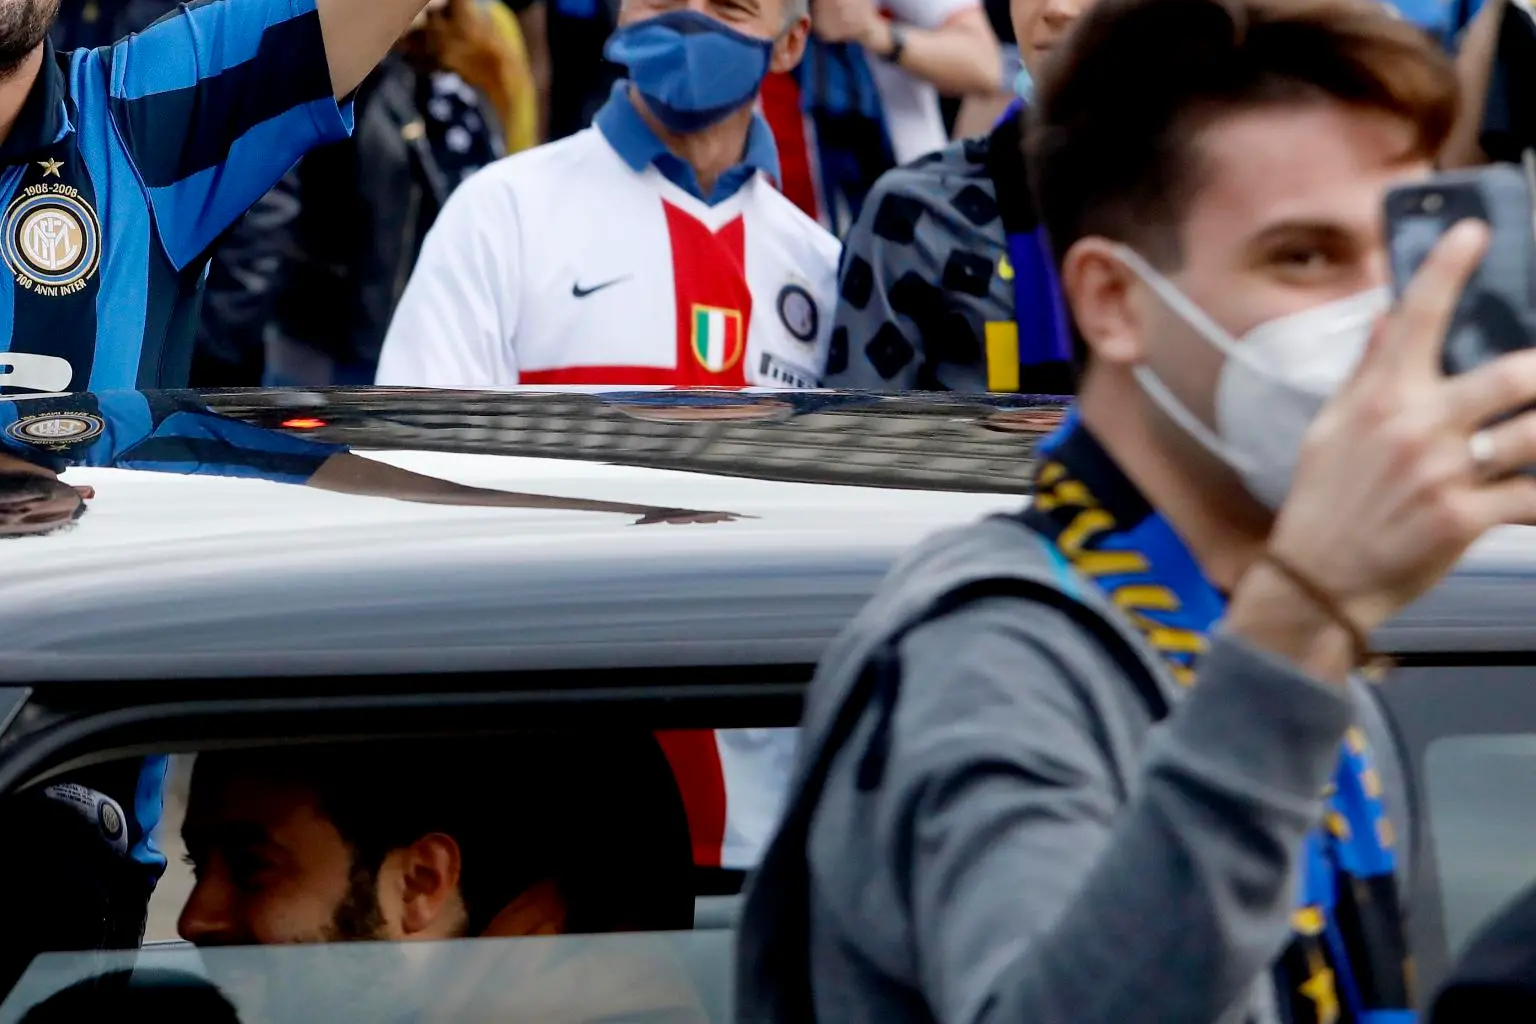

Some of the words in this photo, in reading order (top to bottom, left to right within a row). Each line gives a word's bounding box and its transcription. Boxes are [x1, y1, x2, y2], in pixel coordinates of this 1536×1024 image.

[24, 183, 78, 197] 1908-2008
[16, 273, 33, 289] 100
[34, 284, 58, 296] ANNI
[60, 278, 87, 296] INTER
